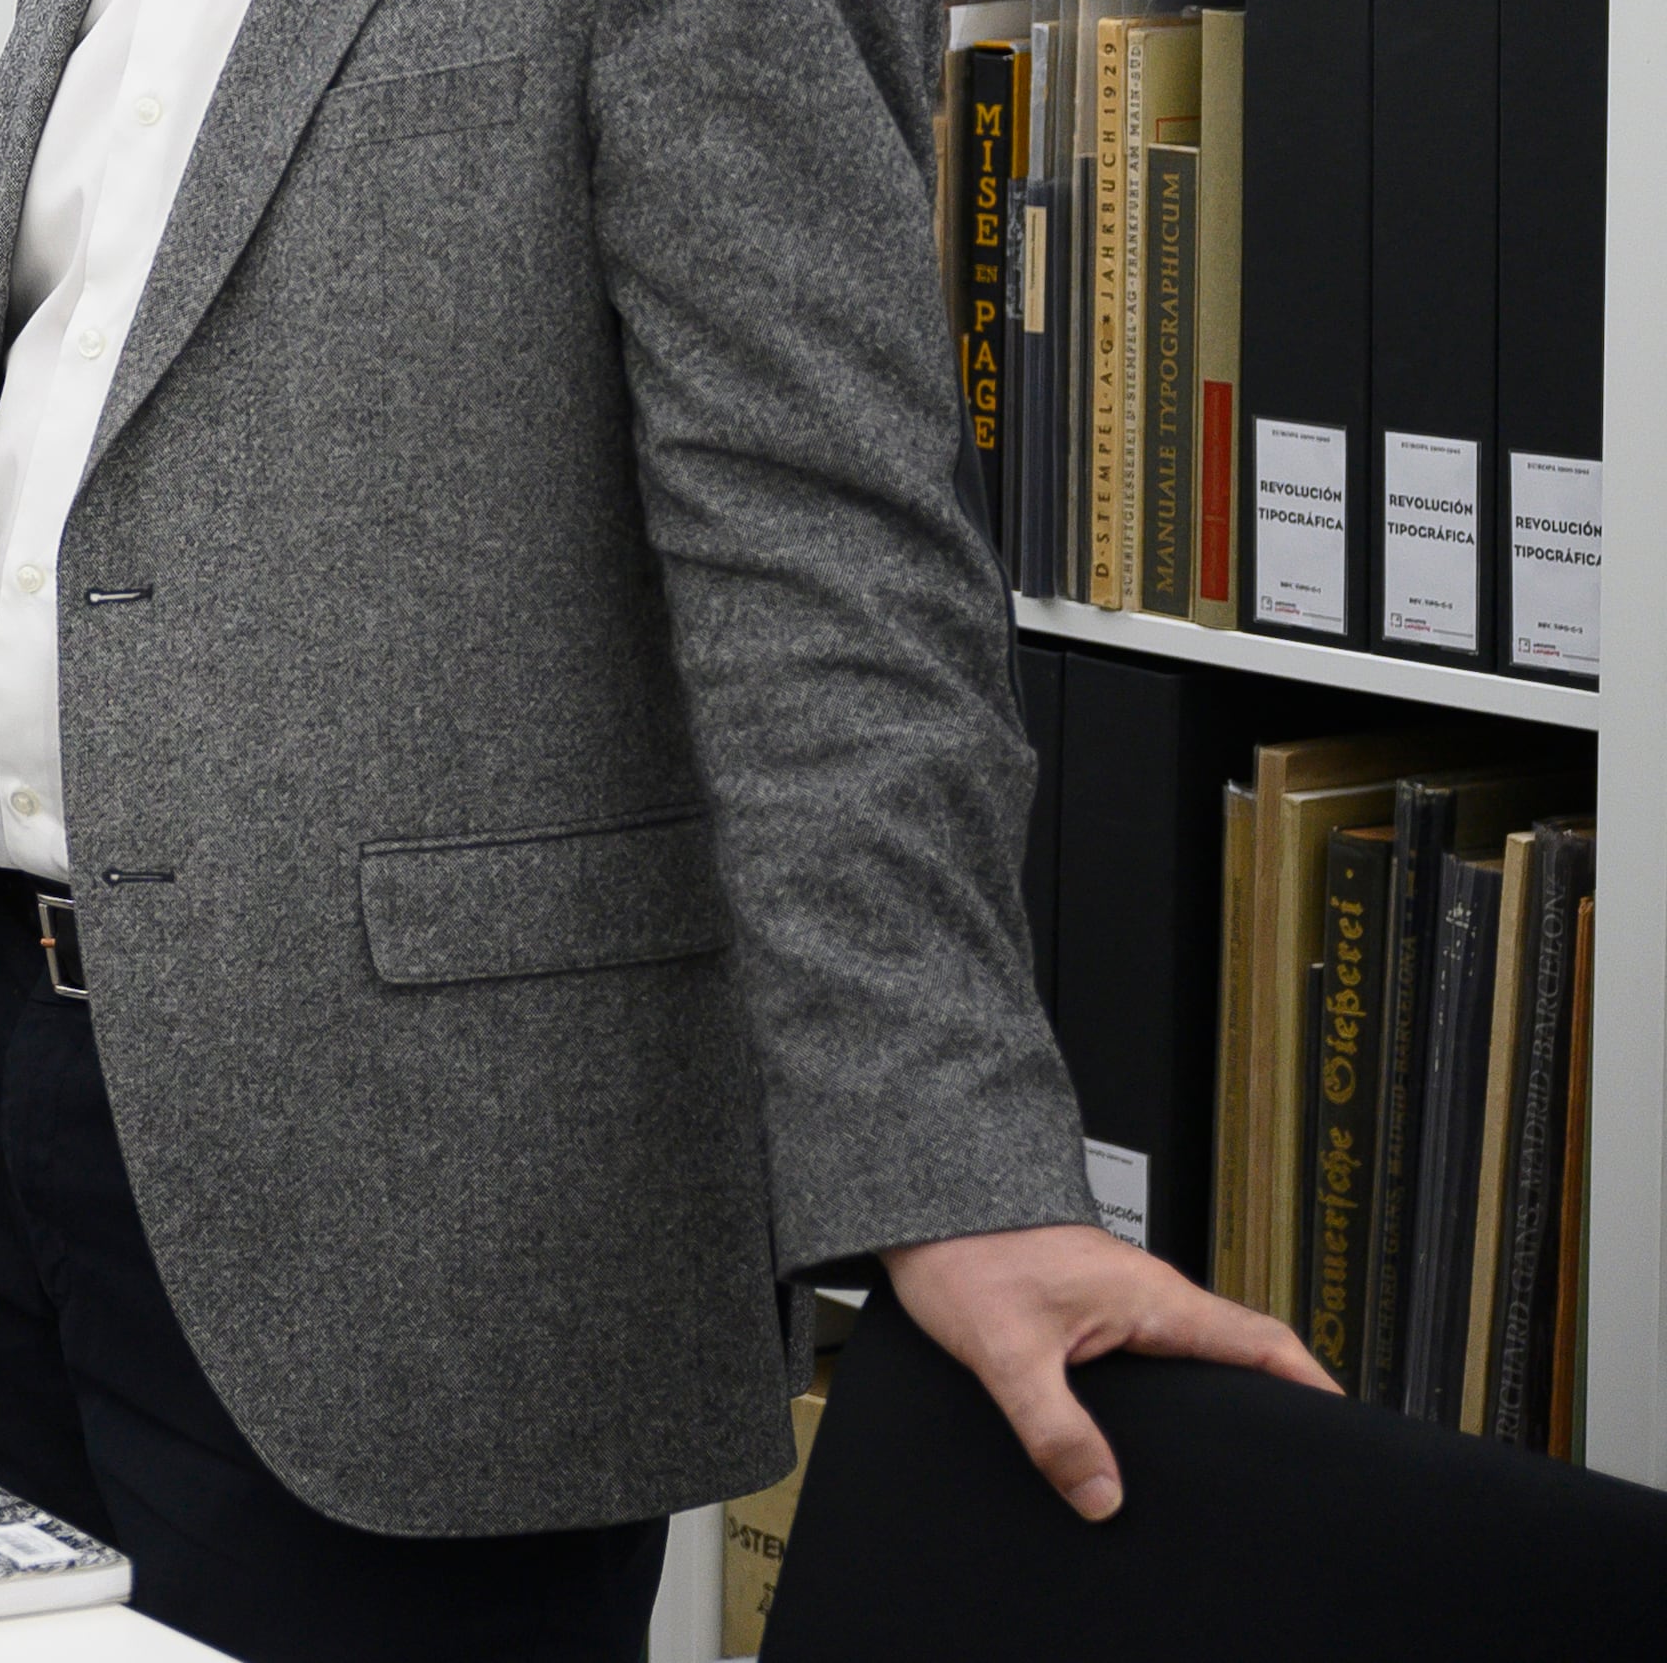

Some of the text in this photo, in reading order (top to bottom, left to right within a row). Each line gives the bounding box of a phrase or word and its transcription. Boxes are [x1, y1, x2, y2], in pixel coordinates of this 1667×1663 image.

[1102, 42, 1118, 116] 1929
[1100, 129, 1116, 302] JAHRBUCH
[974, 103, 1003, 450] MISE EN PAGE
[1156, 172, 1180, 594] MANUALE TYPOGRAPHICUM
[1258, 507, 1344, 531] TIPOGRÁFICA
[1260, 479, 1342, 503] REVOLUCIÓN
[1389, 493, 1473, 516] REVOLUCIÓN
[1516, 515, 1602, 538] REVOLUCIÓN
[1388, 521, 1475, 545] TIPOGRÁFICA
[1376, 1264, 1396, 1372] RICHARD
[1496, 1301, 1528, 1440] RICHARD
